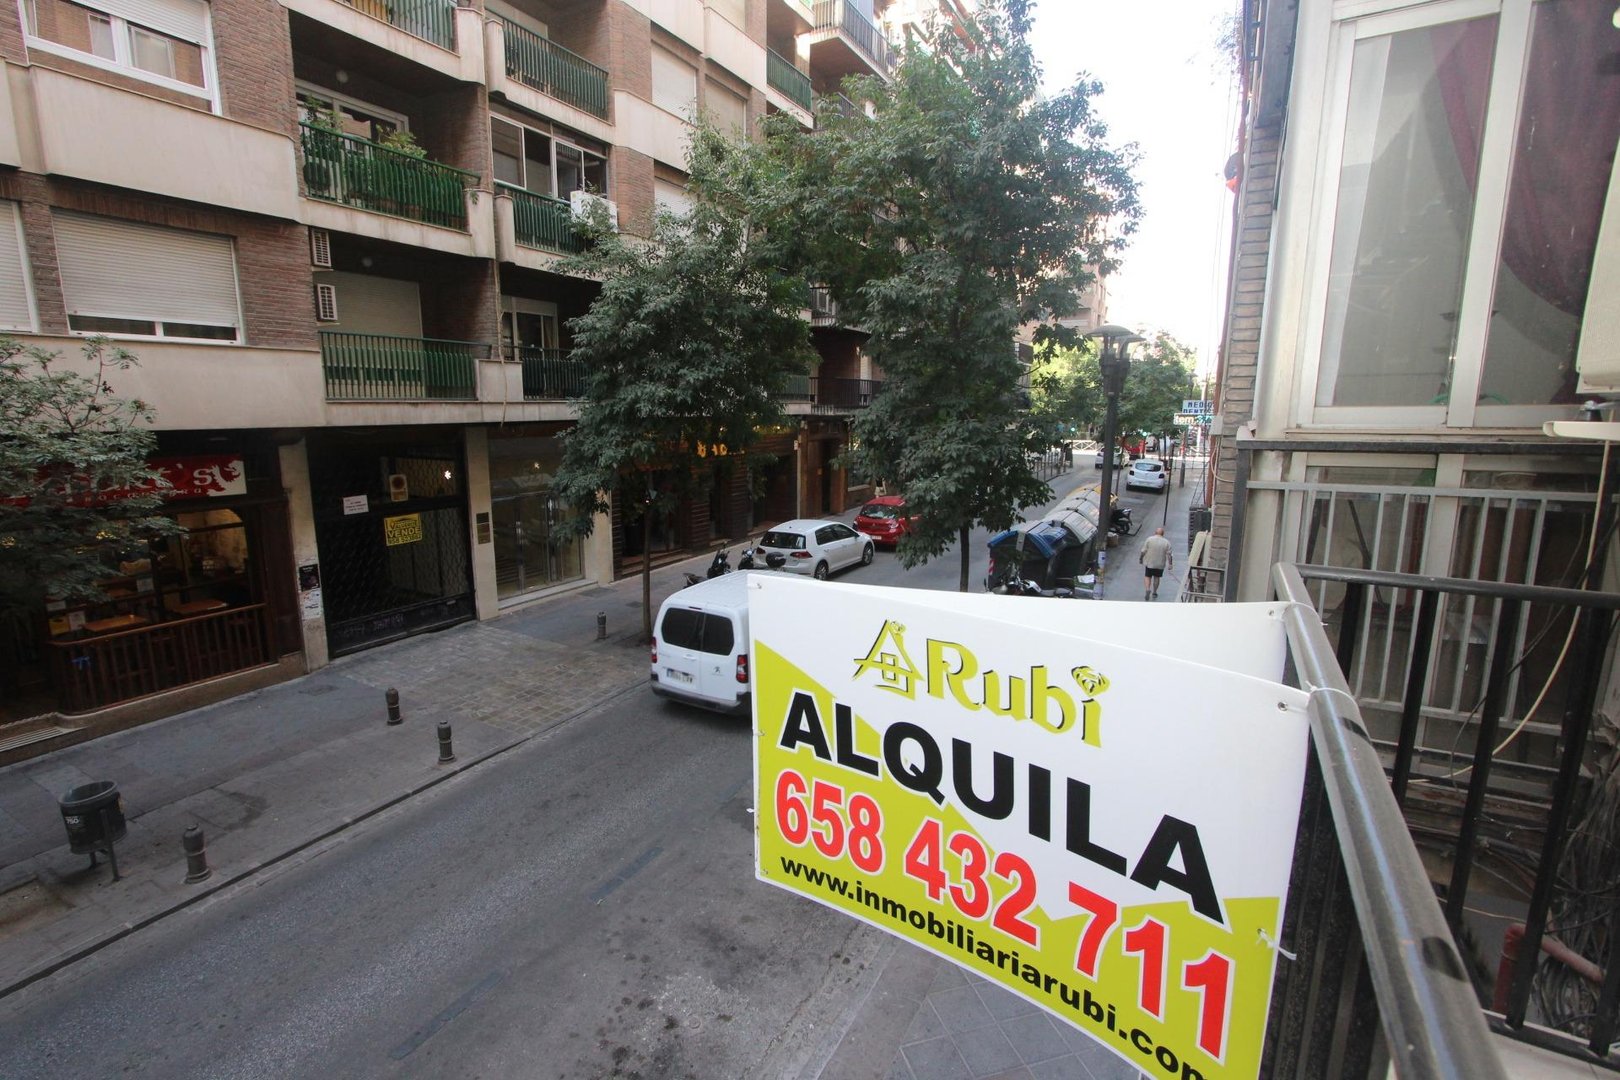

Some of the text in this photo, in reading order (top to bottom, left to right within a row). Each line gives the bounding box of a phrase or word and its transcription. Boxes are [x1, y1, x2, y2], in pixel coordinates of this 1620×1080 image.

[388, 527, 422, 538] VENDE
[776, 770, 1236, 1062] 658 432 711
[780, 691, 1228, 927] ALQUILA
